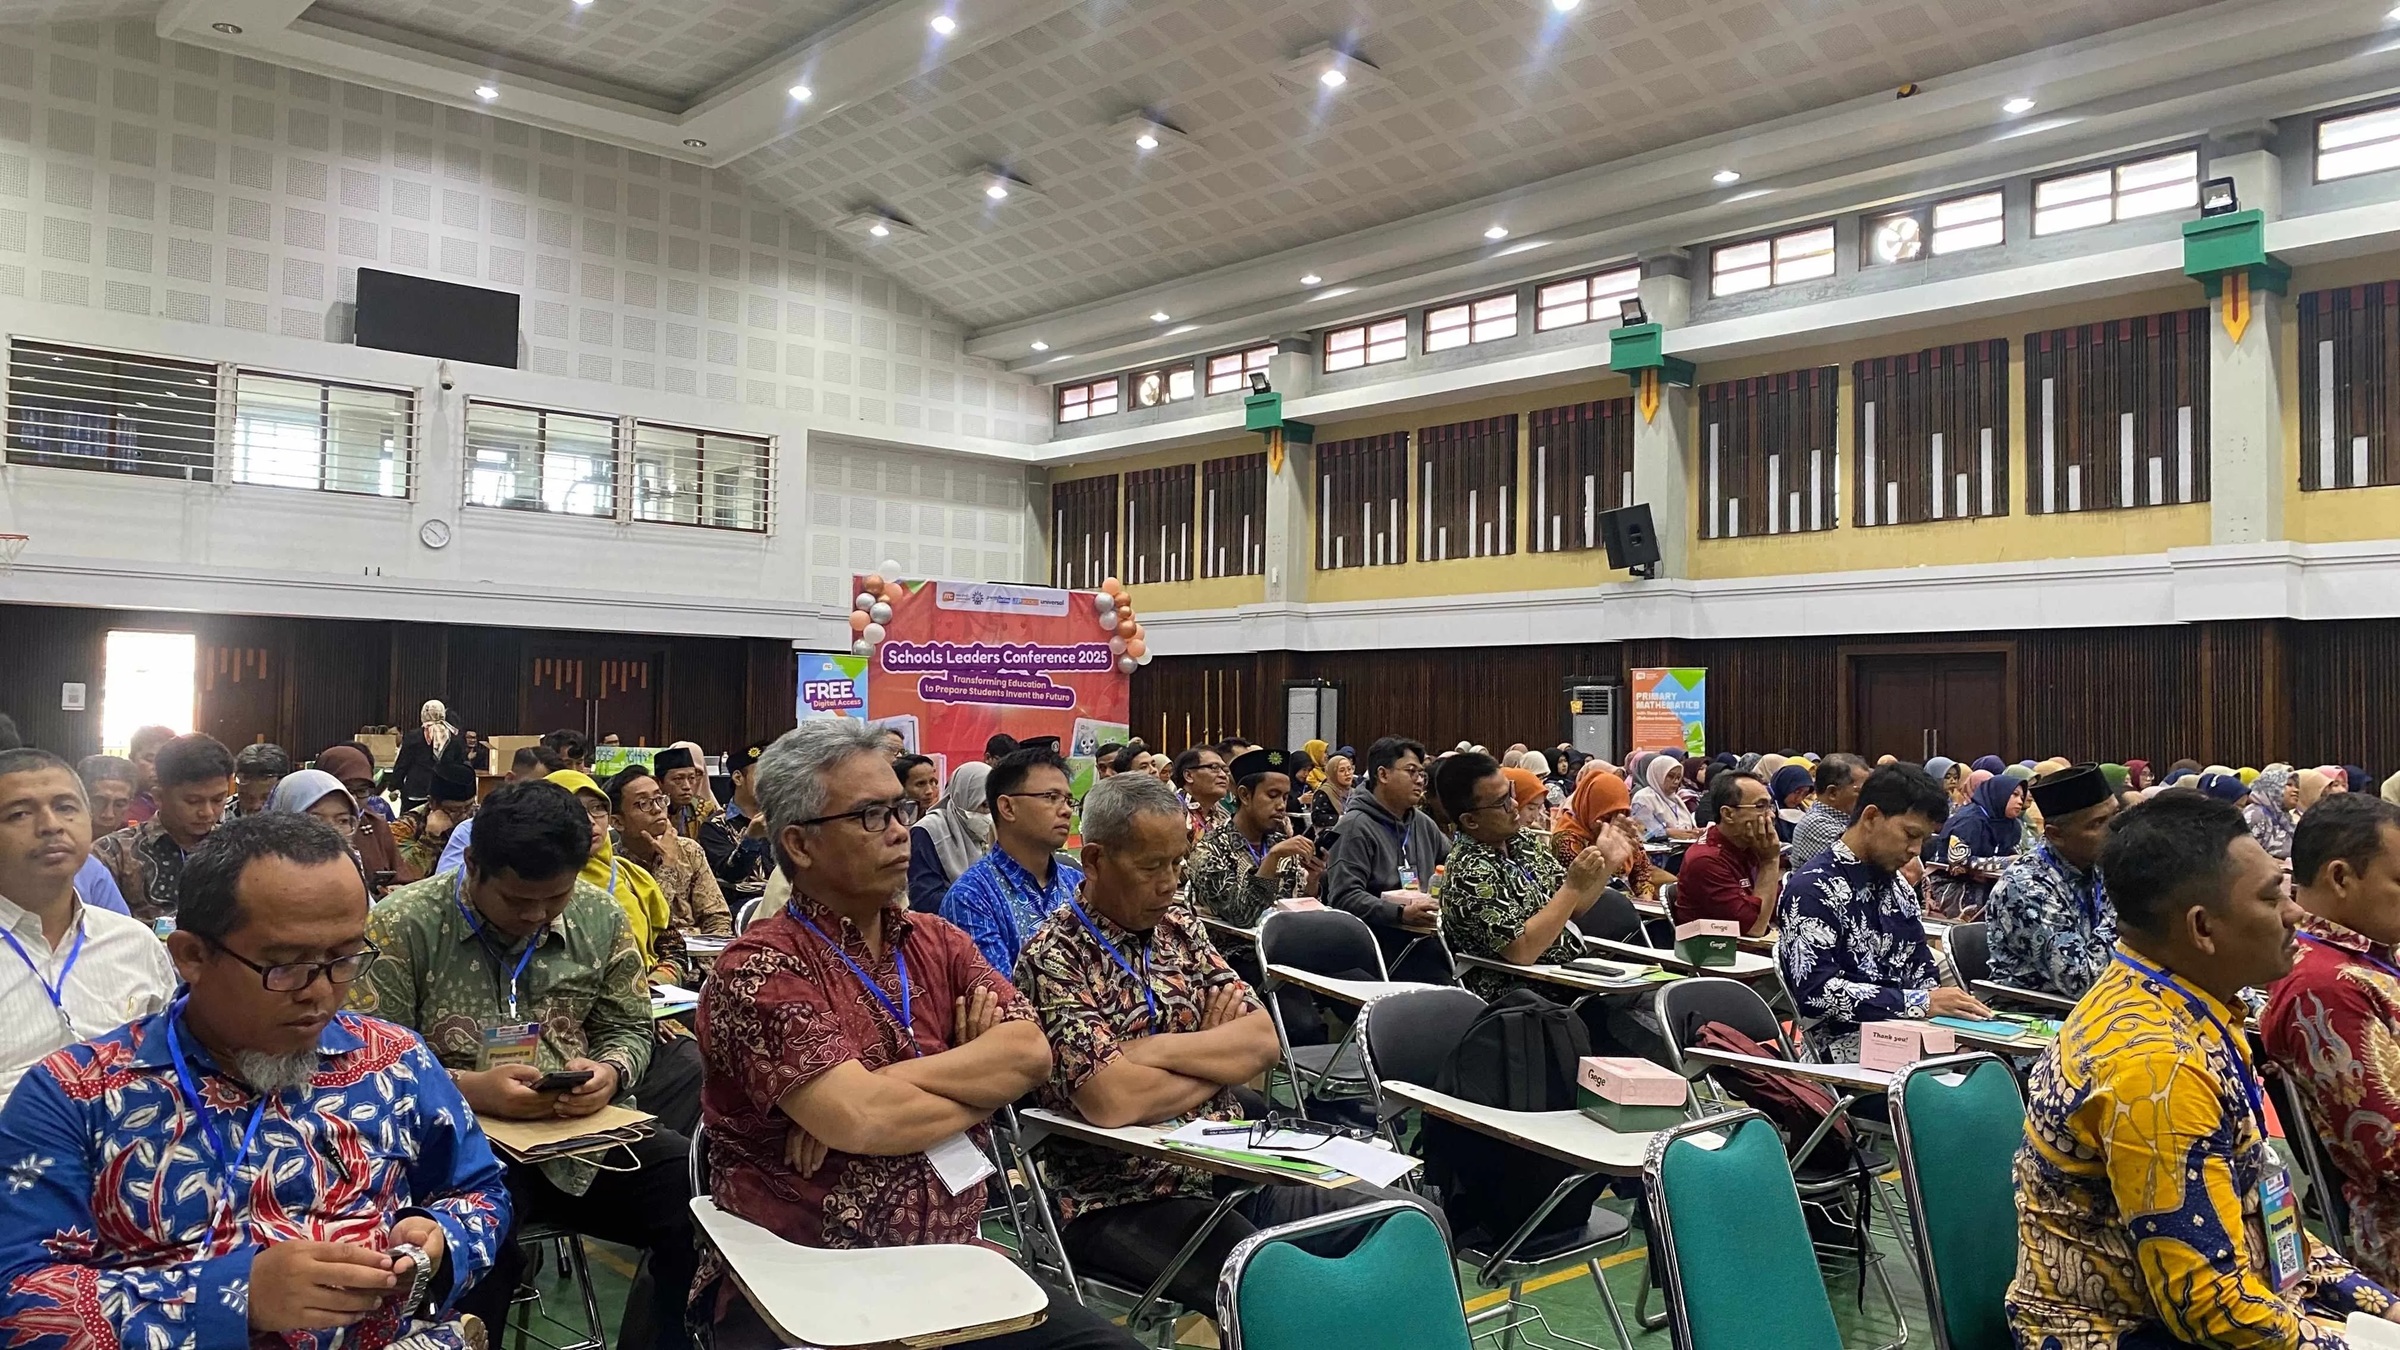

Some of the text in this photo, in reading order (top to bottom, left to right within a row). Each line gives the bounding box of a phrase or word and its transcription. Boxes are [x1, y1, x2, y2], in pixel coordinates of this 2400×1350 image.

[888, 650, 1108, 664] Schools Leaders Conference 2025
[953, 675, 1047, 689] Transforming Education
[805, 681, 853, 700] FREE
[925, 684, 1070, 701] to Prepare Students Invent the Future
[1636, 692, 1677, 701] PRIMARY
[813, 700, 836, 708] Digital
[1636, 701, 1700, 710] MATHEMATICS
[1873, 1031, 1893, 1040] Thank
[1587, 1068, 1606, 1088] Gege
